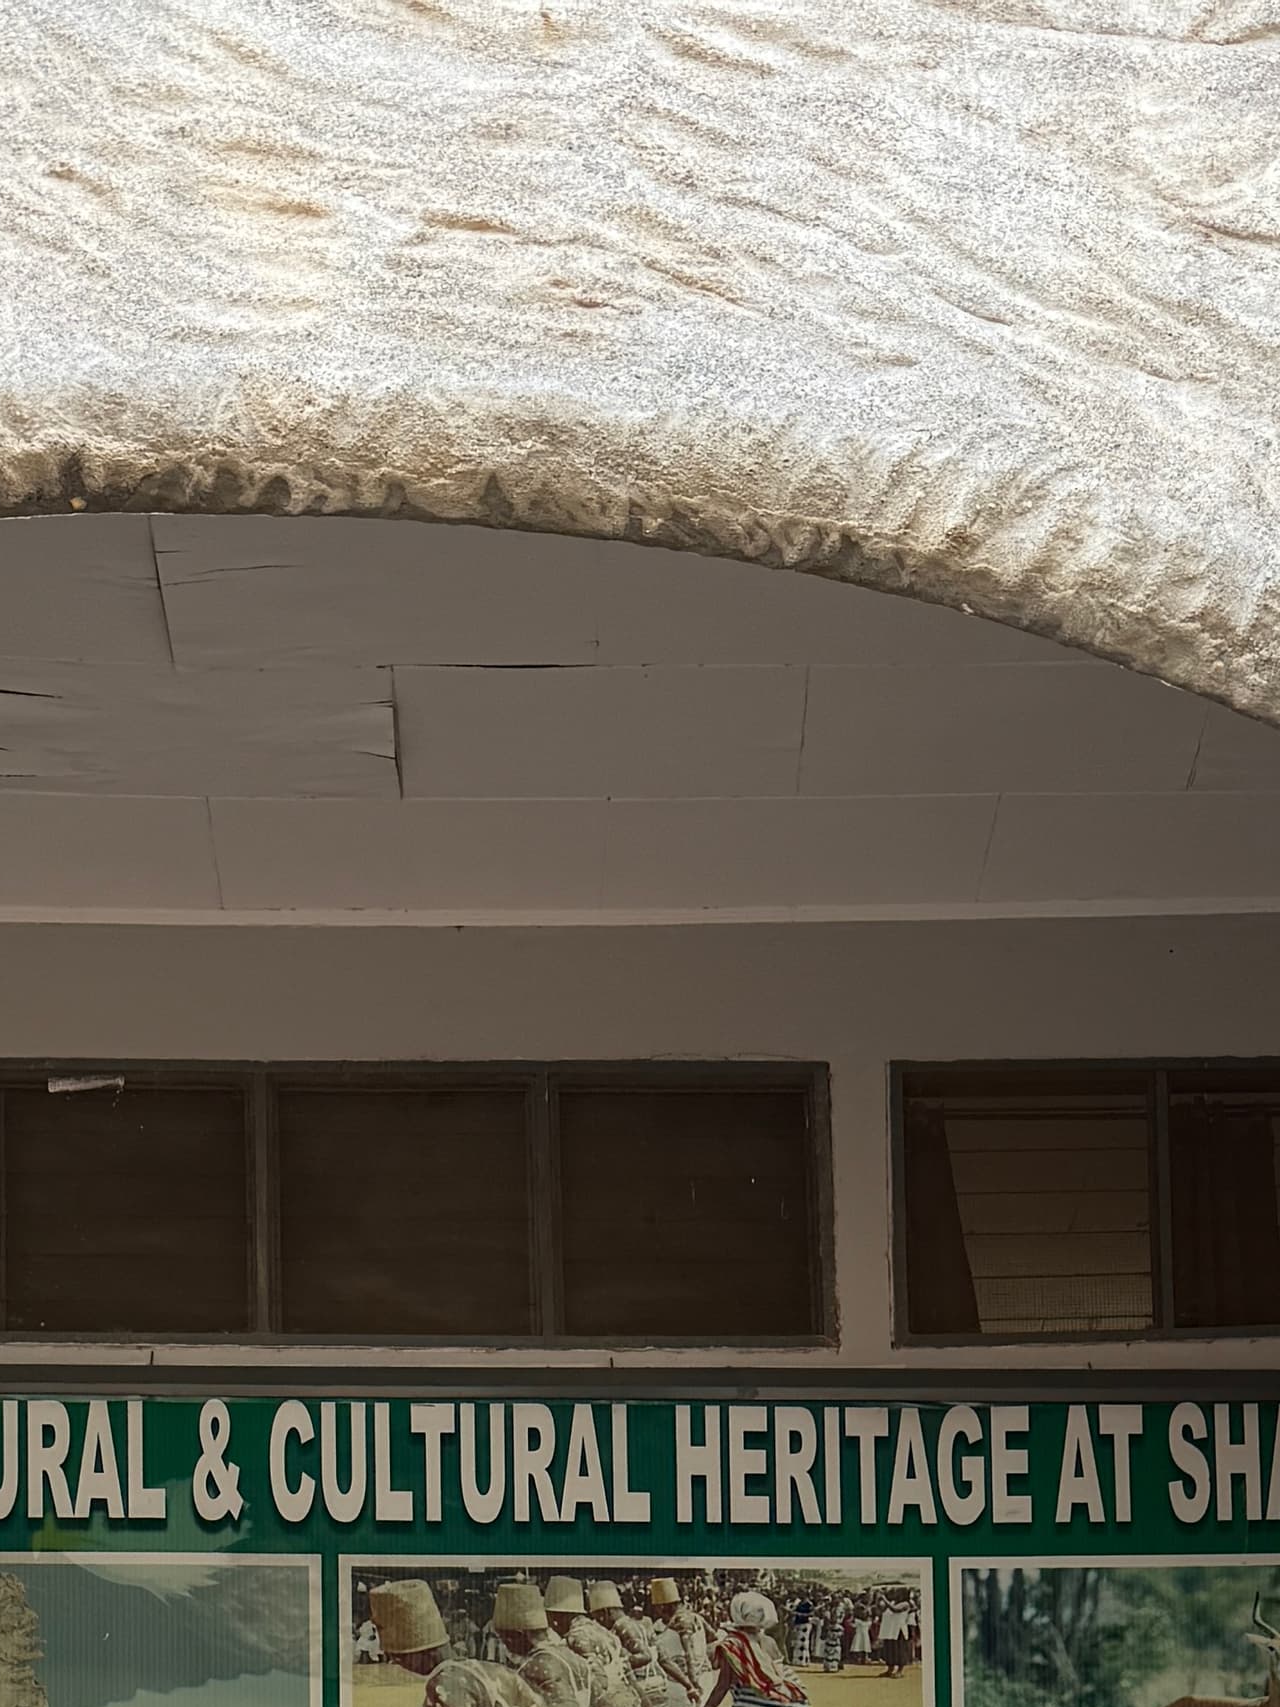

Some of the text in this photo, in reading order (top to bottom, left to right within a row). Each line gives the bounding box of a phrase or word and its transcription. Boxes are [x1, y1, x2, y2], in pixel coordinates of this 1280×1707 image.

[191, 1398, 245, 1522] &
[269, 1400, 651, 1524] CULTURAL
[675, 1403, 1033, 1526] HERITAGE
[1055, 1403, 1144, 1524] AT
